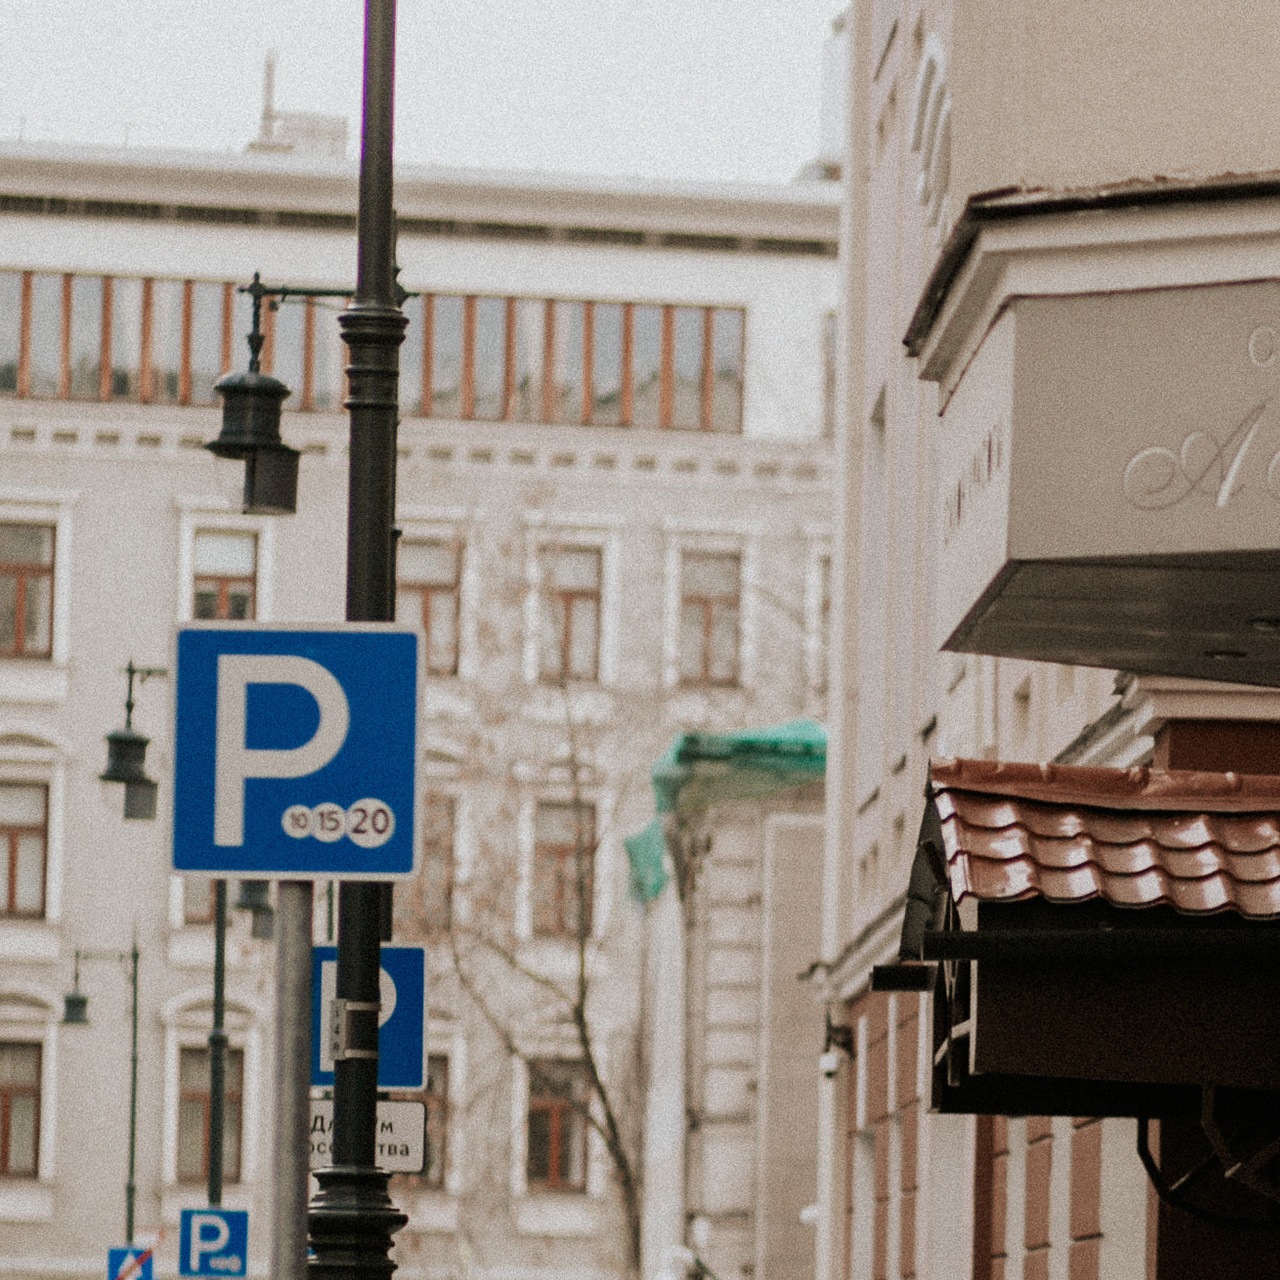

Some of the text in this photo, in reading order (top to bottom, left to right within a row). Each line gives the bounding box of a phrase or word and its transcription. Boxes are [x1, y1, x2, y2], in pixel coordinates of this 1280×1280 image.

[213, 654, 349, 846] P
[319, 810, 340, 831] 15
[352, 808, 390, 834] 20
[190, 1214, 230, 1272] P
